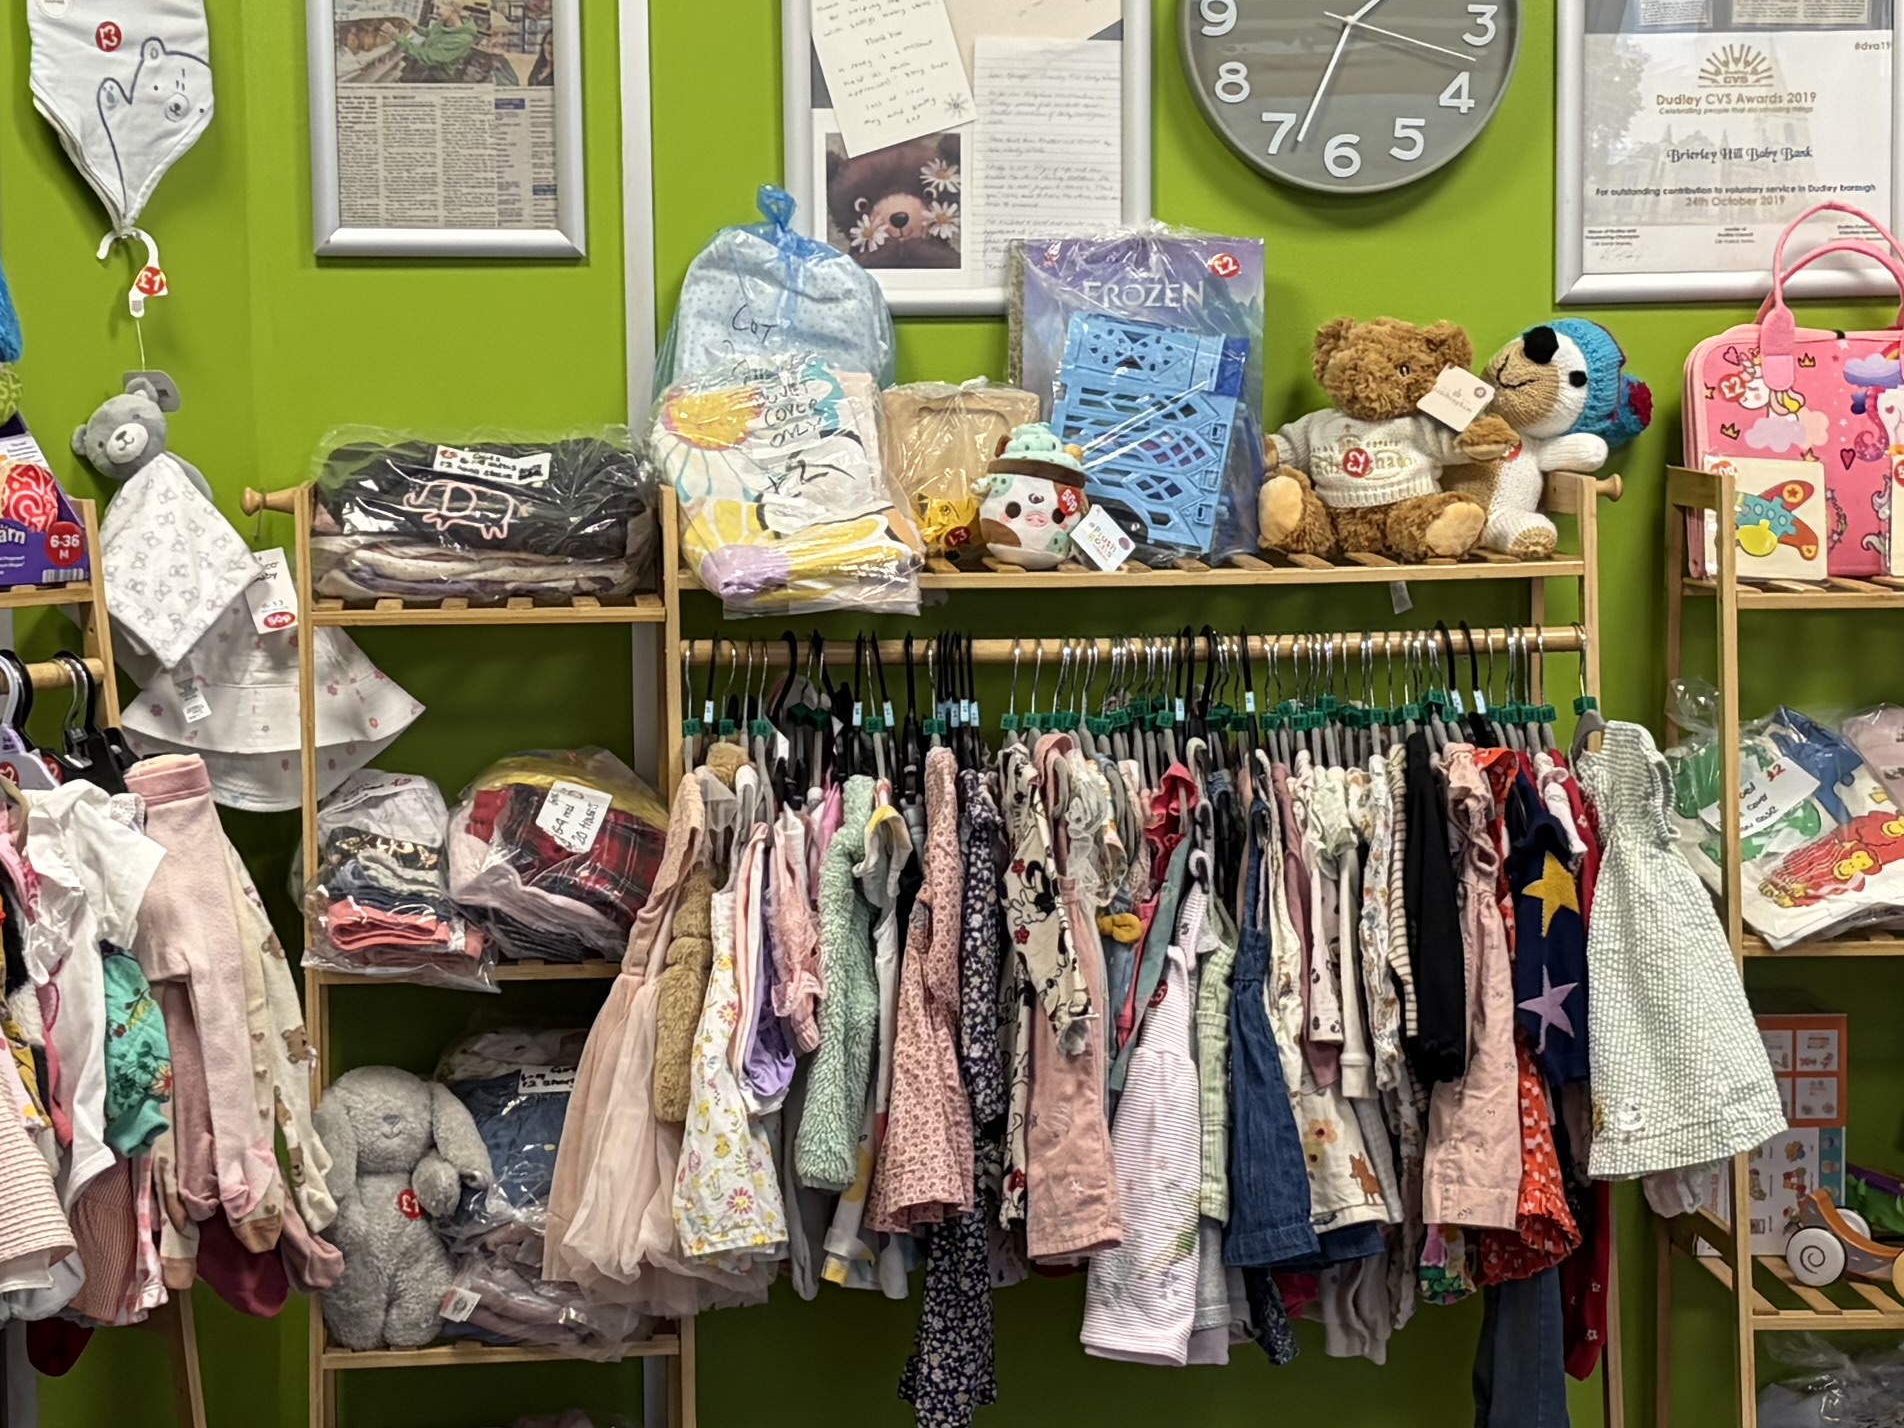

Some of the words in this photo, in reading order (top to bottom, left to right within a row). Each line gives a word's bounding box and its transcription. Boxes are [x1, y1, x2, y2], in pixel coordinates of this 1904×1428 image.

[1462, 4, 1498, 46] 3
[1214, 61, 1250, 103] 8
[1439, 72, 1475, 114] 4
[1655, 92, 1701, 108] Dudley
[1705, 92, 1733, 106] CVS
[1735, 92, 1783, 105] Awards
[1786, 91, 1817, 104] 2019
[1261, 112, 1297, 155] 7
[1389, 118, 1426, 160] 5
[1323, 134, 1362, 177] 6
[1214, 257, 1238, 275] £2
[1083, 281, 1204, 308] FROZEN
[50, 534, 80, 548] 6-36
